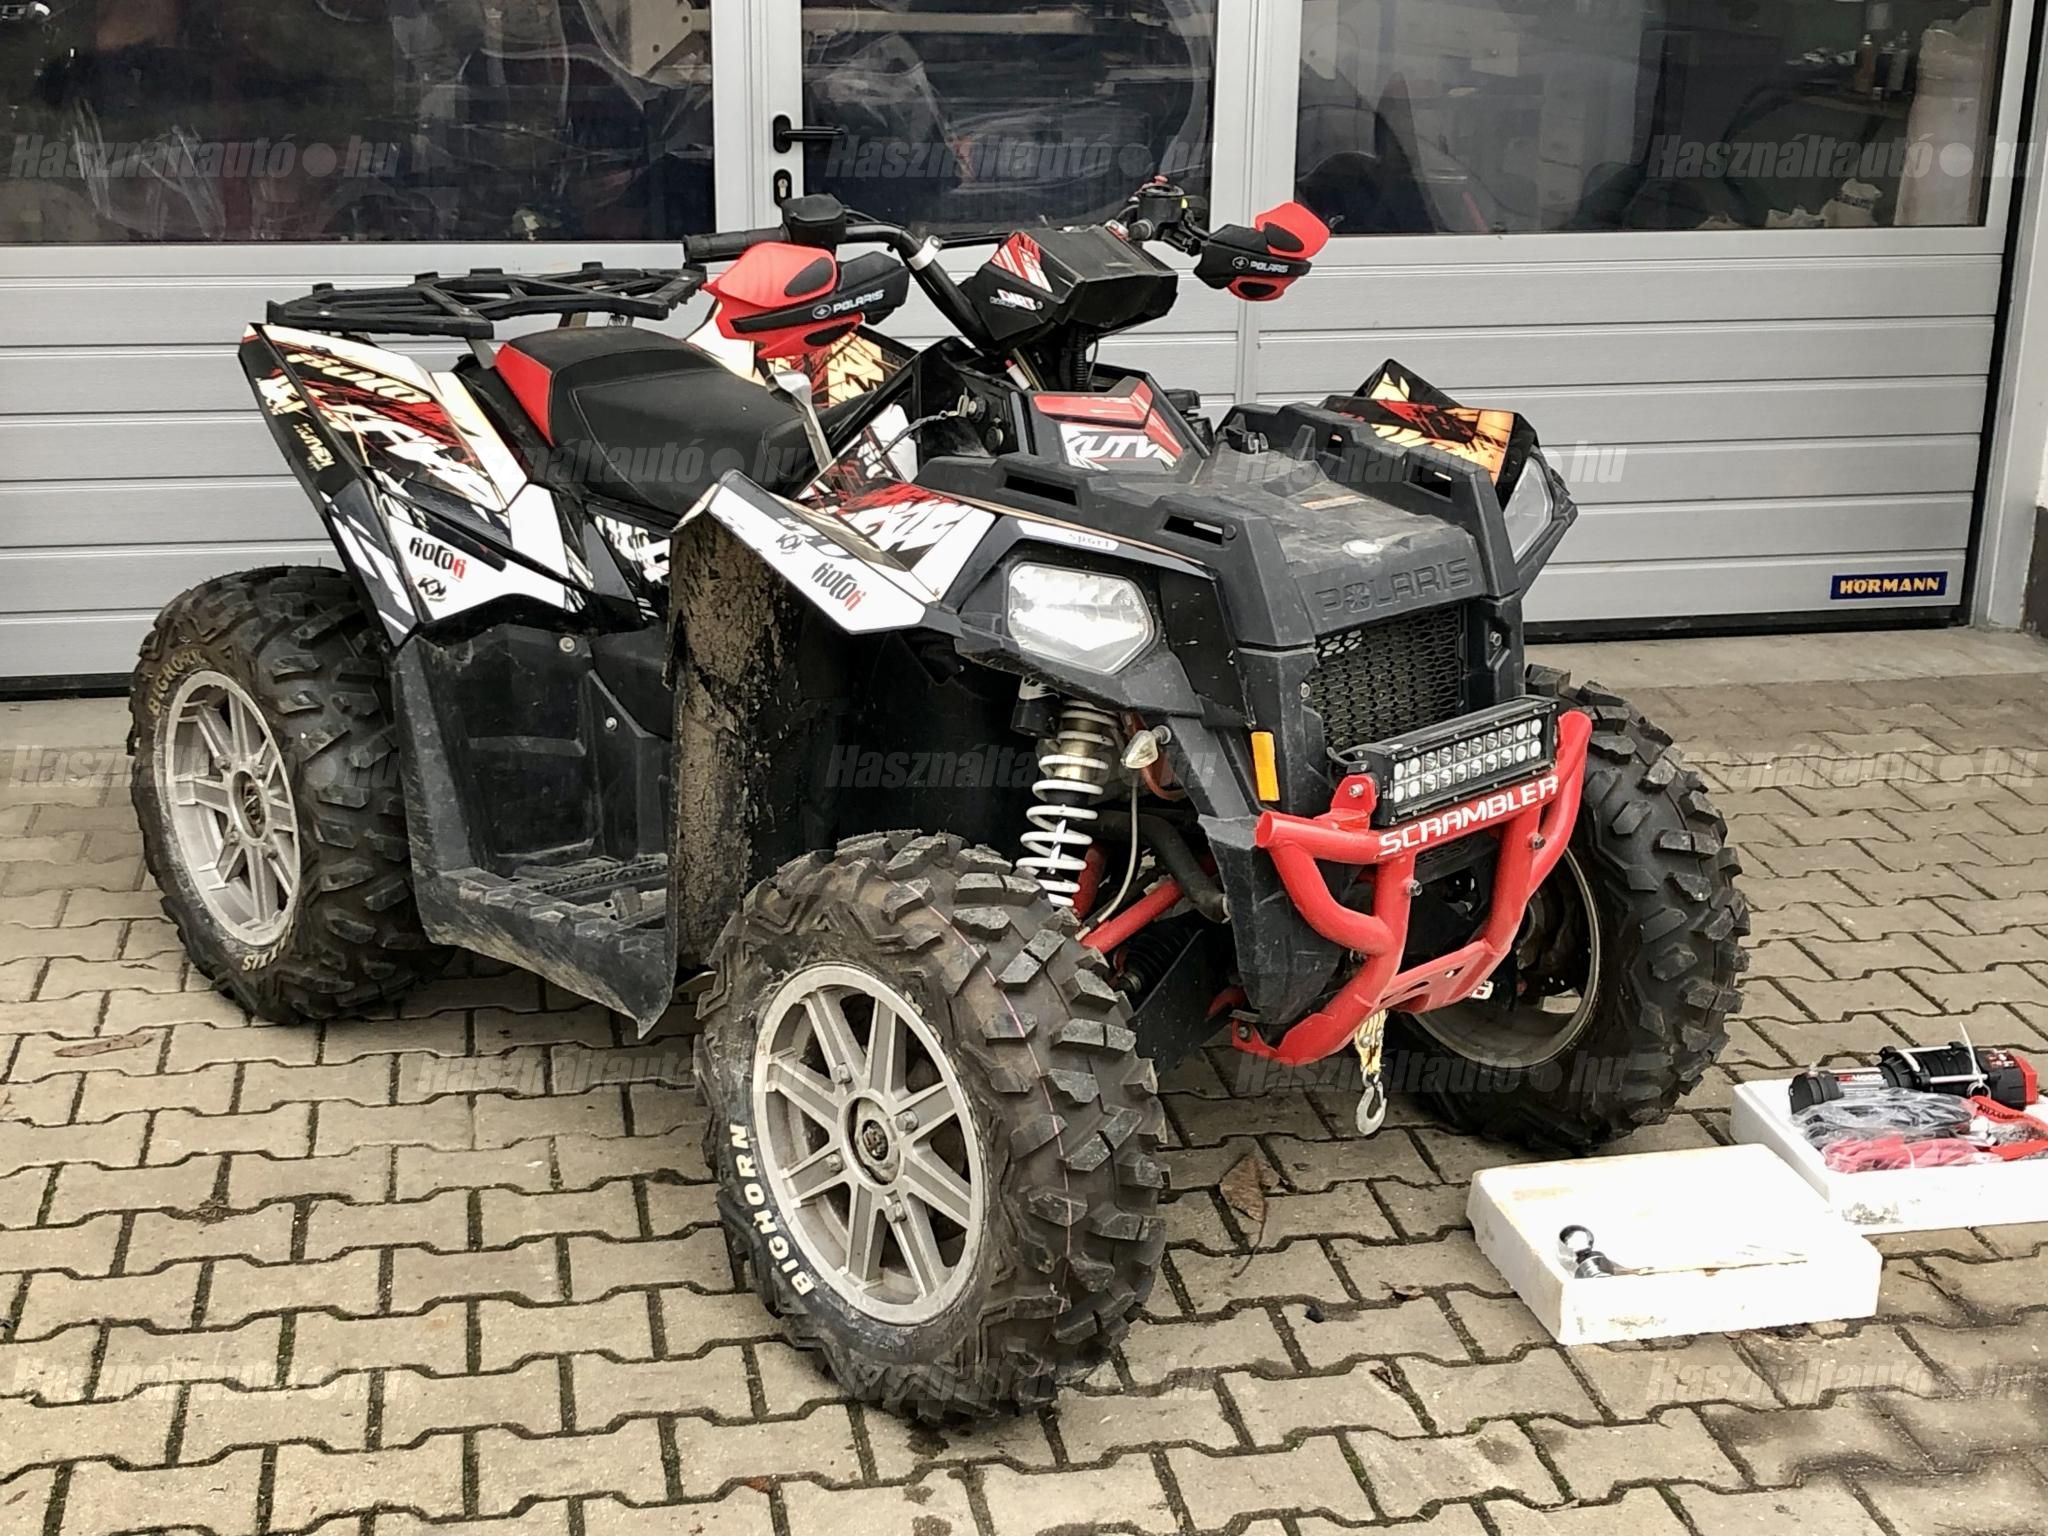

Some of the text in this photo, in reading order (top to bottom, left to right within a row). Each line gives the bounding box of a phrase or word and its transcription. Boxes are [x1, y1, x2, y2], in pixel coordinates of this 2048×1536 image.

[1250, 260, 1289, 273] POLARIS
[833, 289, 885, 313] POLARIS
[1315, 557, 1473, 620] POLARIS
[149, 648, 207, 717] BIGHORN
[1379, 774, 1560, 857] SCRAMBLER
[729, 1123, 815, 1296] BIGHORN
